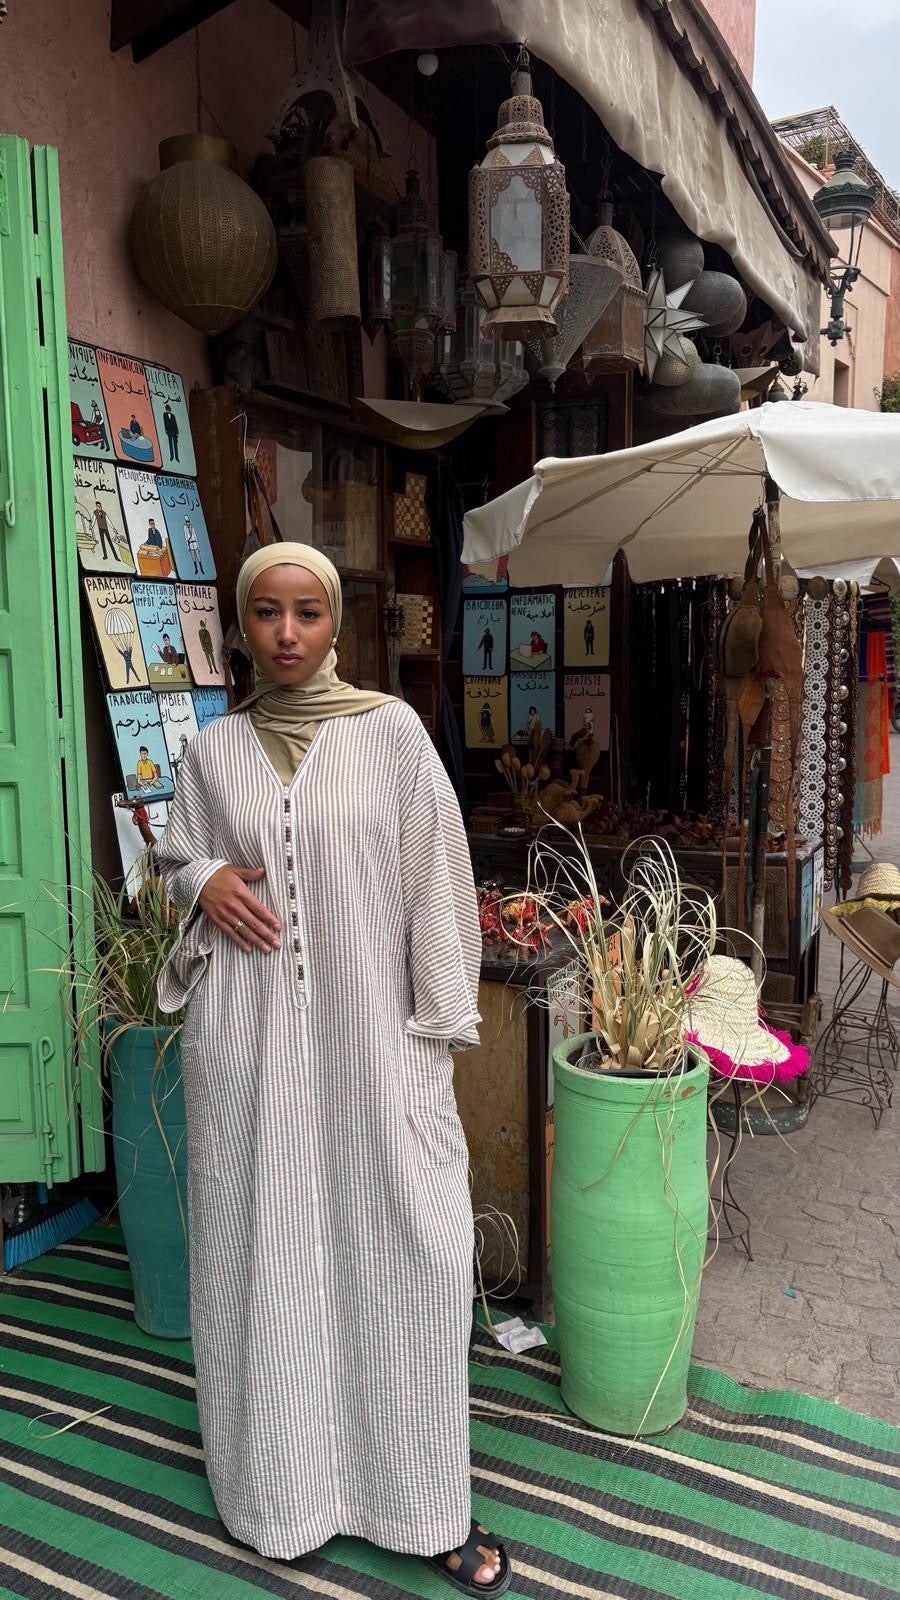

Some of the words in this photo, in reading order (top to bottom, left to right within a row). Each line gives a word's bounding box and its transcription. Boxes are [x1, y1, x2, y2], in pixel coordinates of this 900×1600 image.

[97, 350, 145, 377] INFORMATICIEN
[157, 476, 196, 491] GENDARMERIE
[86, 577, 132, 592] PARACHUT
[132, 583, 168, 596] INSPECTEUR
[175, 583, 212, 600] MILITAIRE
[465, 601, 504, 611] BRICOLEUR
[140, 611, 177, 633] الضرائب
[565, 675, 601, 686] DENTISTE
[108, 692, 157, 707] TRADUCTEUR
